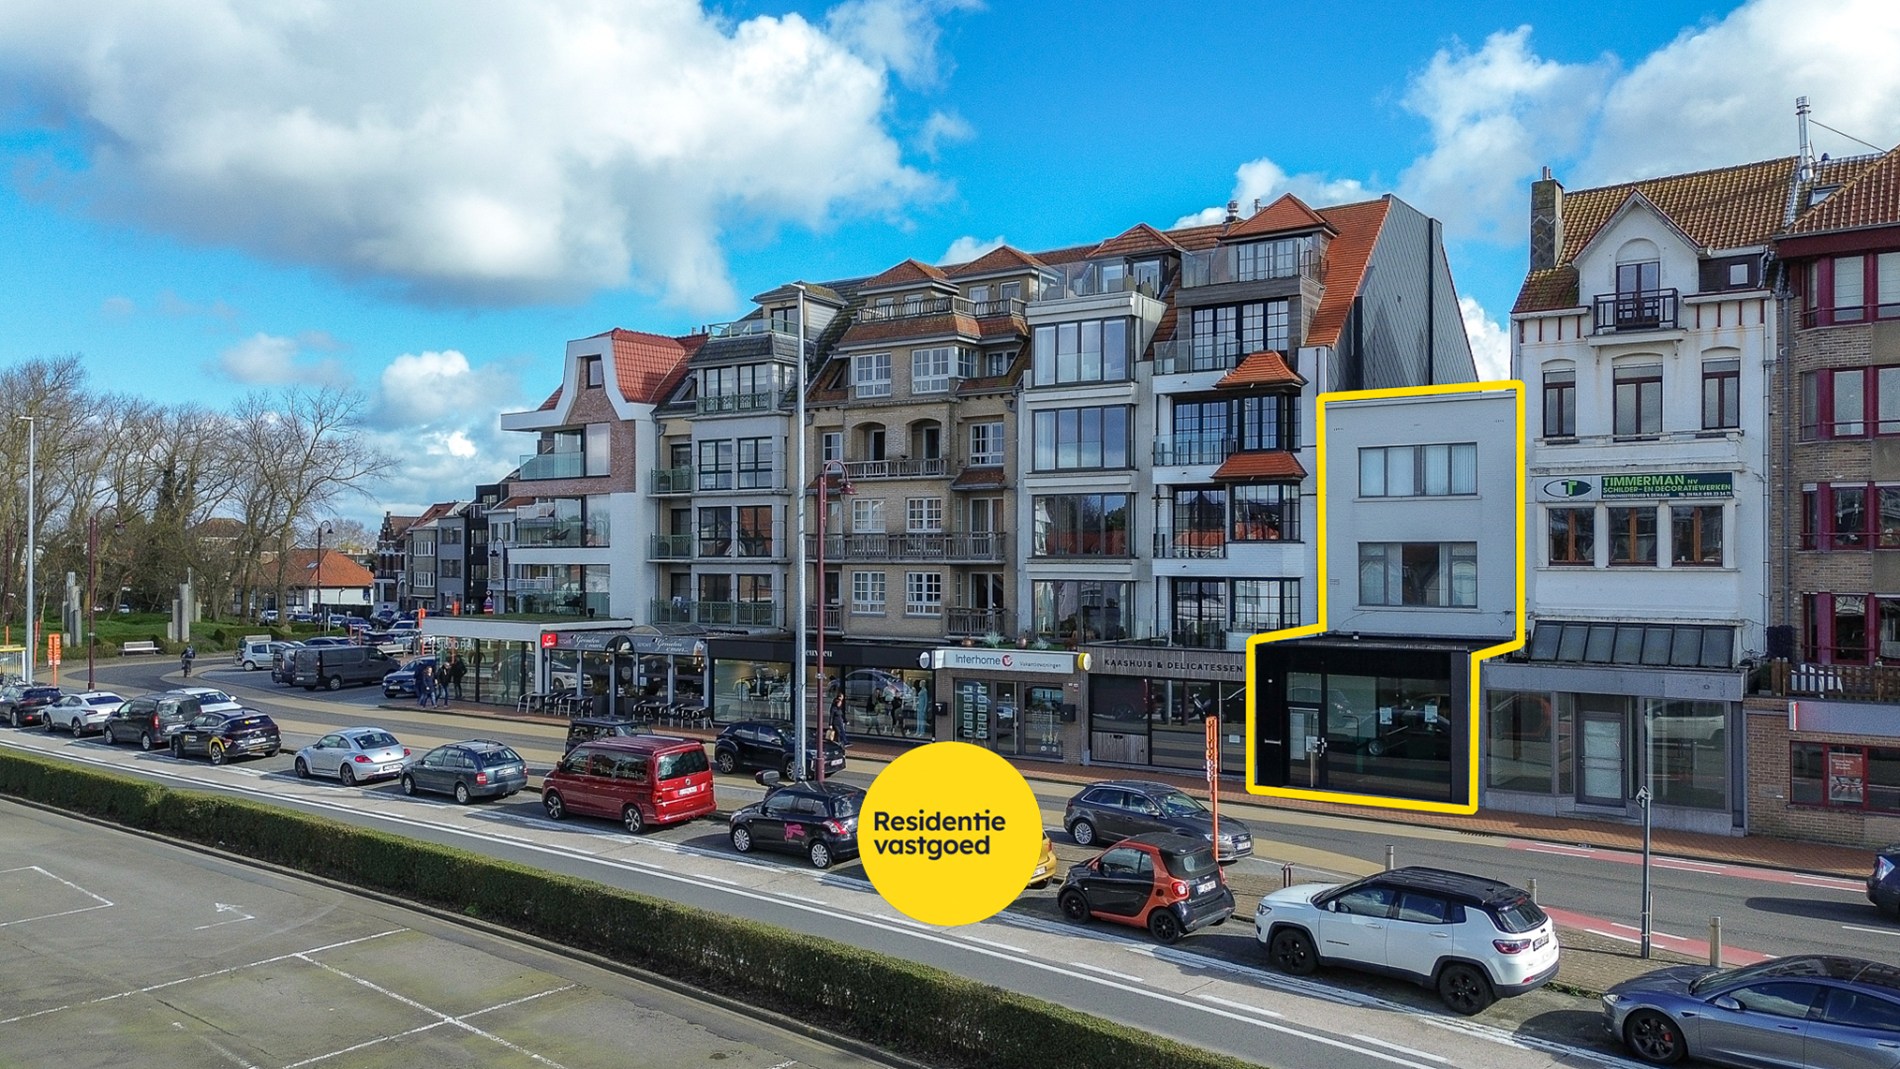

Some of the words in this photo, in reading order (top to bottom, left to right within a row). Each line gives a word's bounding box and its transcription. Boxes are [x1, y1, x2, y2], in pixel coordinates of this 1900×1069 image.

[1602, 475, 1684, 487] TIMMERMAN
[1602, 486, 1643, 494] SCHILDER-
[1655, 484, 1731, 492] DECORATIEWERKEN
[955, 654, 1001, 665] Interhome
[1104, 659, 1153, 668] KAASHUIS
[1167, 662, 1243, 672] DELICATESSEN
